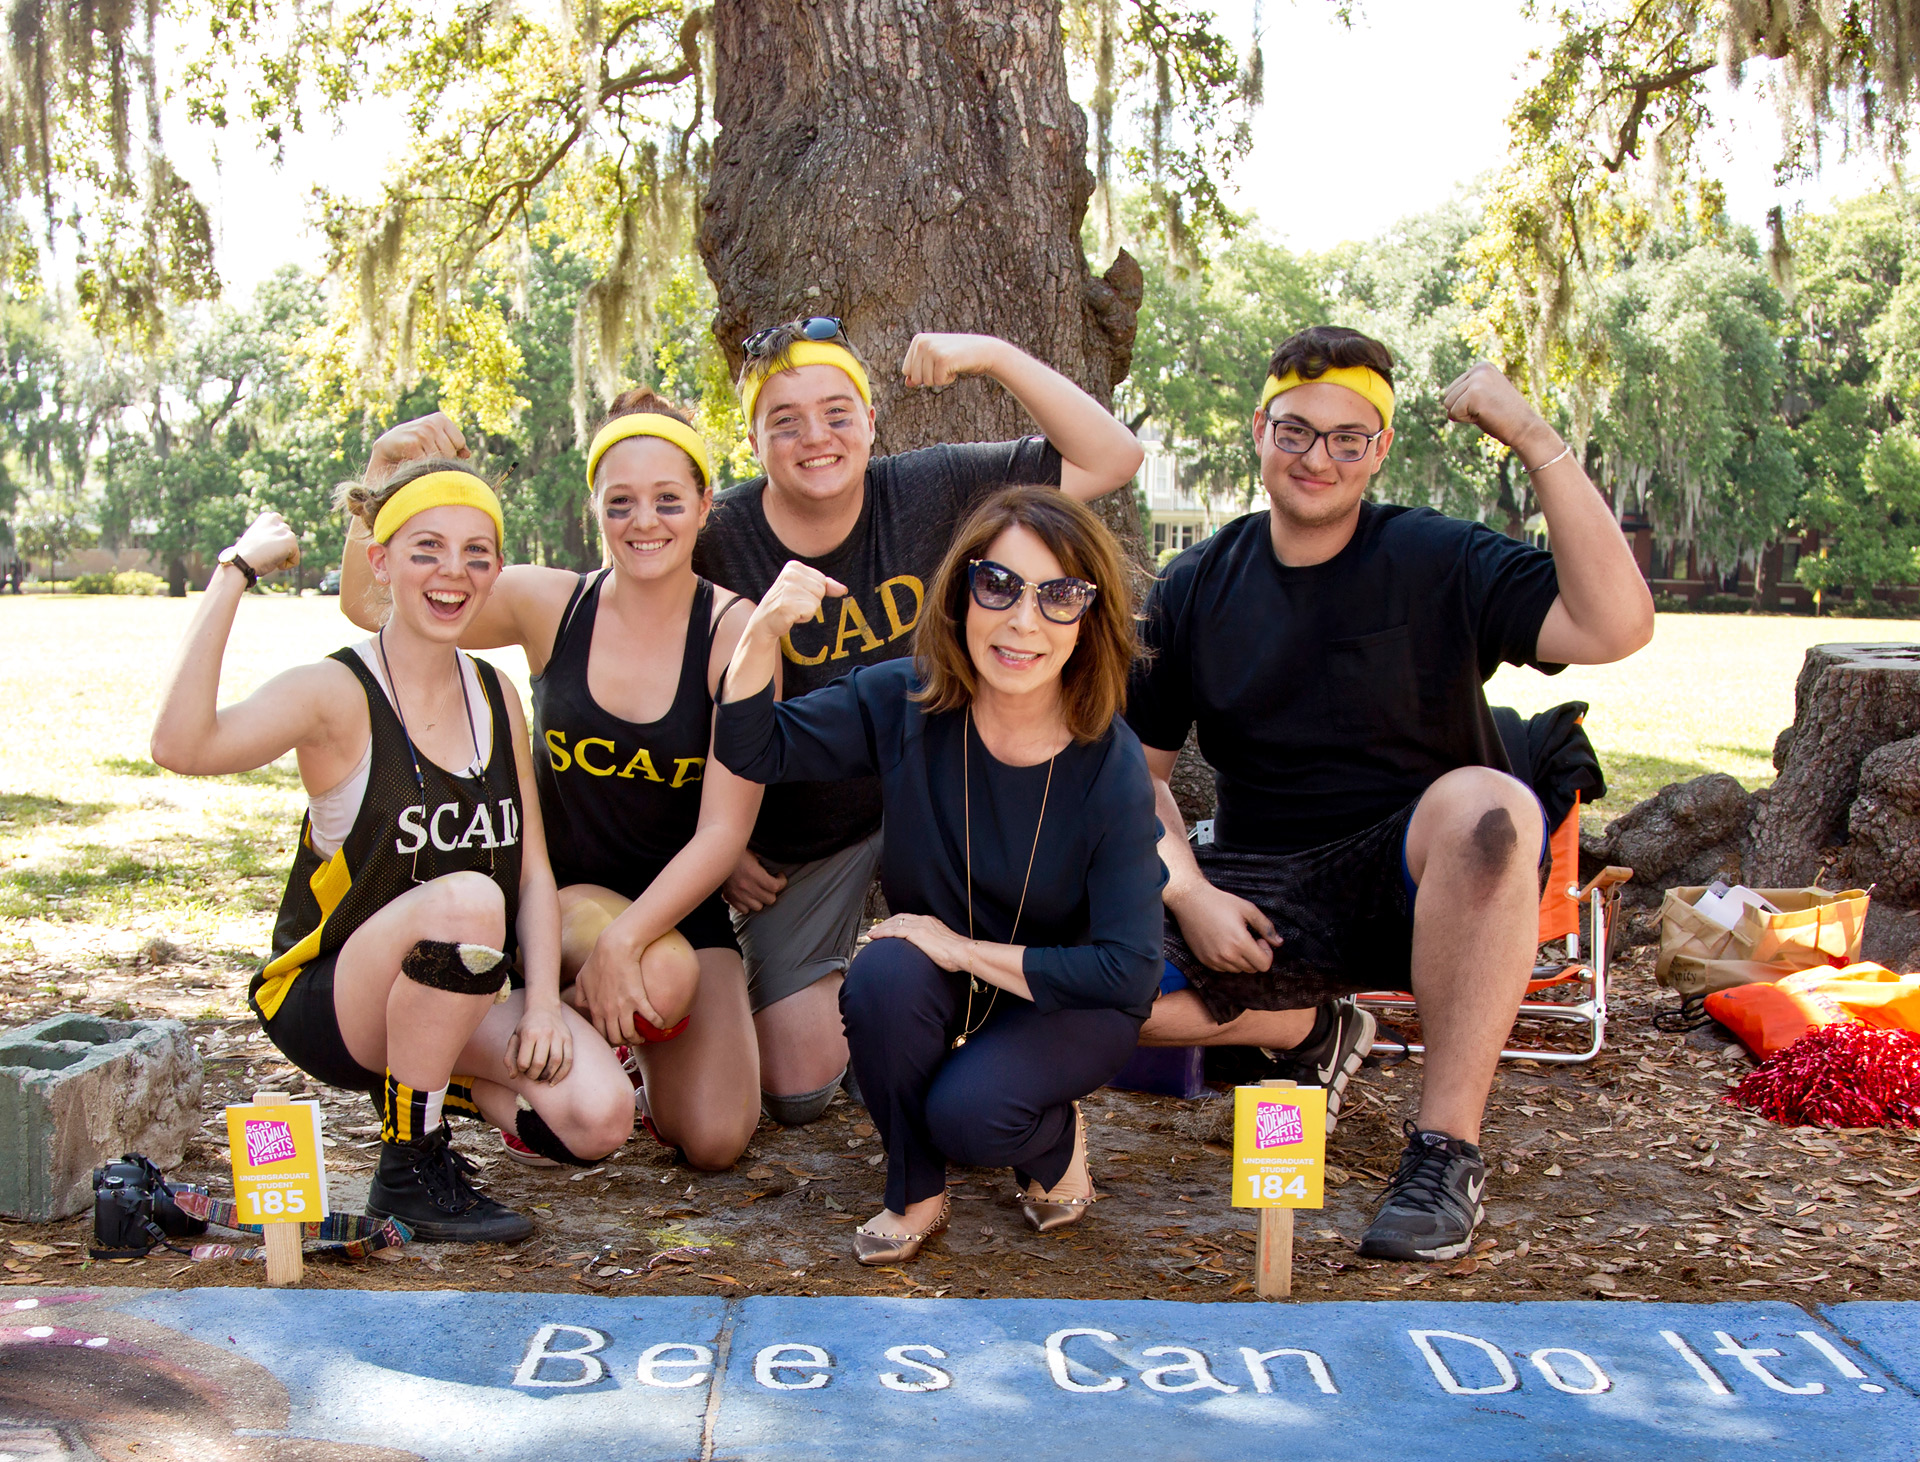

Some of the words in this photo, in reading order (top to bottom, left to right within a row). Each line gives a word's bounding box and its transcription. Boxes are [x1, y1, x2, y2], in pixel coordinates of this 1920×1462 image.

[781, 574, 925, 666] CAD
[545, 729, 705, 788] SCAD
[396, 798, 519, 854] SCAD
[1257, 1104, 1283, 1115] SCAD
[246, 1121, 271, 1133] SCAD
[1256, 1105, 1300, 1140] SIDEWALK
[1266, 1121, 1302, 1139] ARTS
[246, 1121, 290, 1157] SIDEWALK
[260, 1137, 293, 1156] ARTS
[1260, 1135, 1304, 1149] FESTIVAL
[253, 1150, 297, 1167] FESTIVAL
[1242, 1157, 1314, 1165] UNDERGRADUATE
[239, 1172, 310, 1181] UNDERGRADUATE
[1259, 1166, 1296, 1174] STUDENT
[256, 1181, 294, 1190] STUDENT
[1248, 1175, 1307, 1199] 184
[247, 1189, 306, 1215] 185
[511, 1323, 955, 1392] Bees
[1044, 1327, 1342, 1394] Can
[1407, 1329, 1614, 1395] Do
[1659, 1330, 1886, 1395] It!
